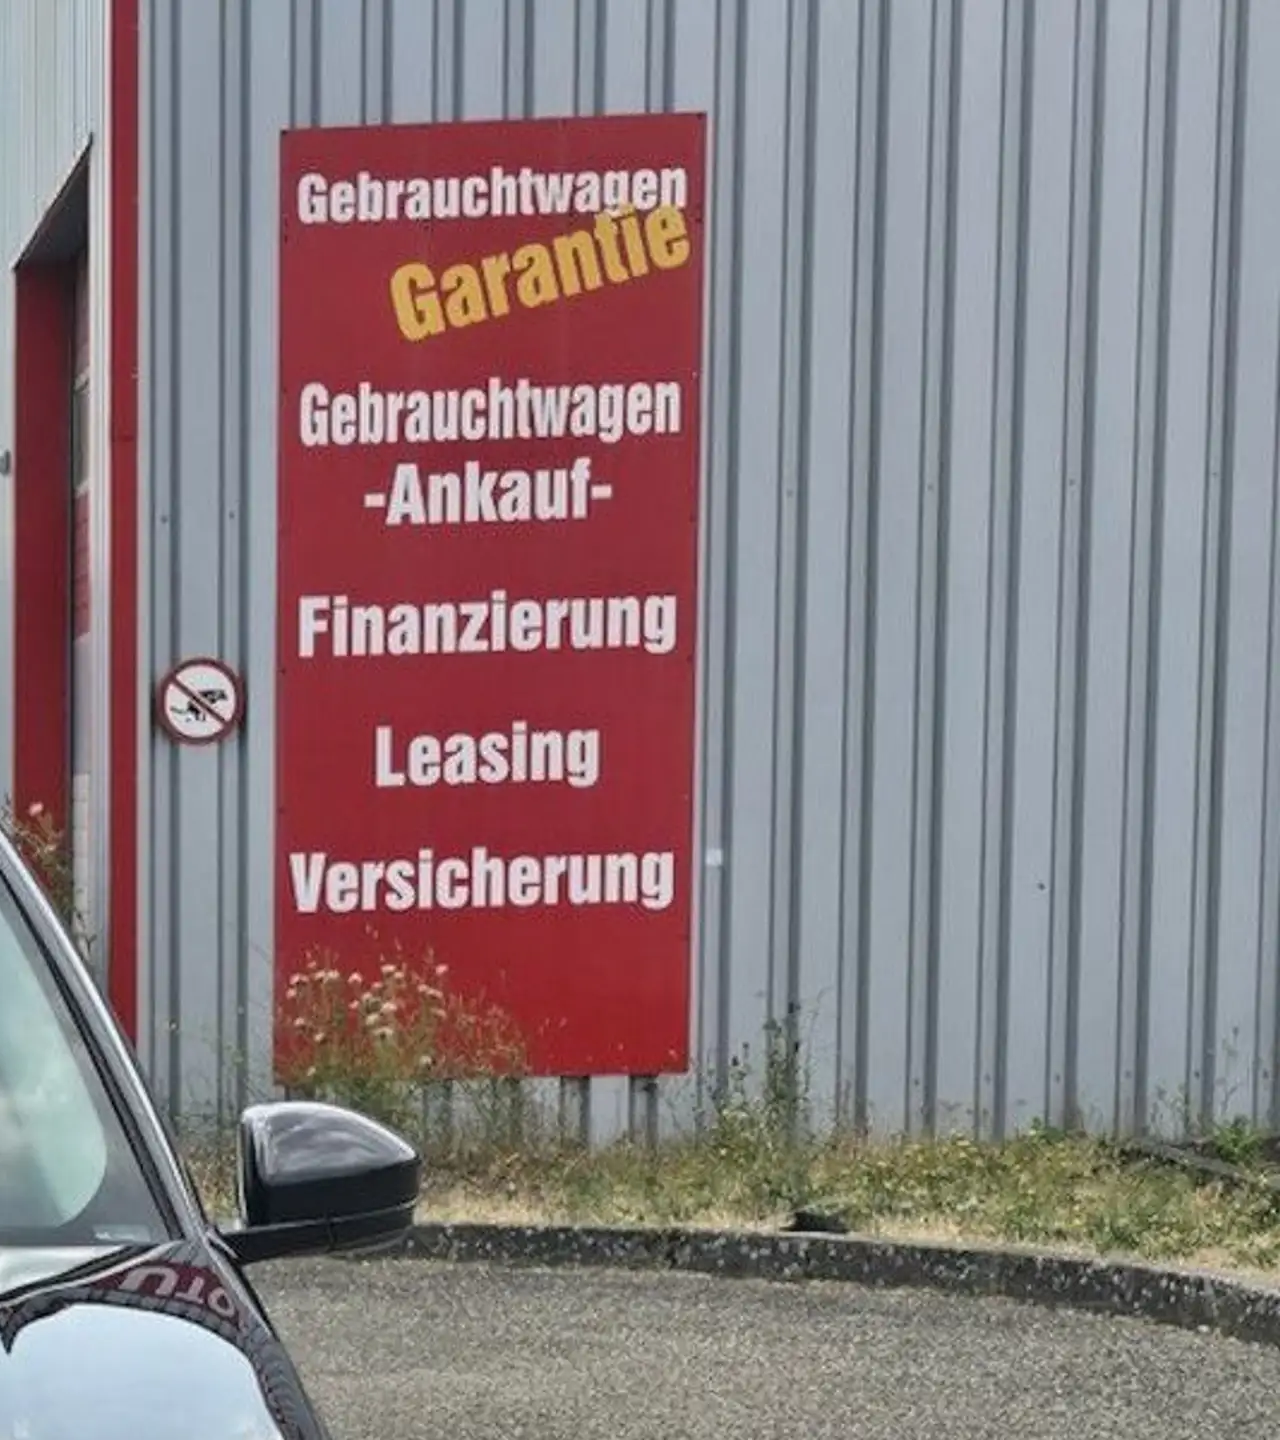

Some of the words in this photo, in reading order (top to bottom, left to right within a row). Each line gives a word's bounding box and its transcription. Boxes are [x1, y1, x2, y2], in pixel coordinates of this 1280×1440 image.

[297, 166, 687, 224] Gebrauchtwagen
[390, 203, 690, 342] Garantie
[299, 376, 681, 446] Gebrauchtwagen
[364, 456, 613, 526] -Ankauf-
[298, 589, 677, 658] Finanzierung
[375, 720, 600, 788] Leasing
[289, 846, 674, 913] Versicherung
